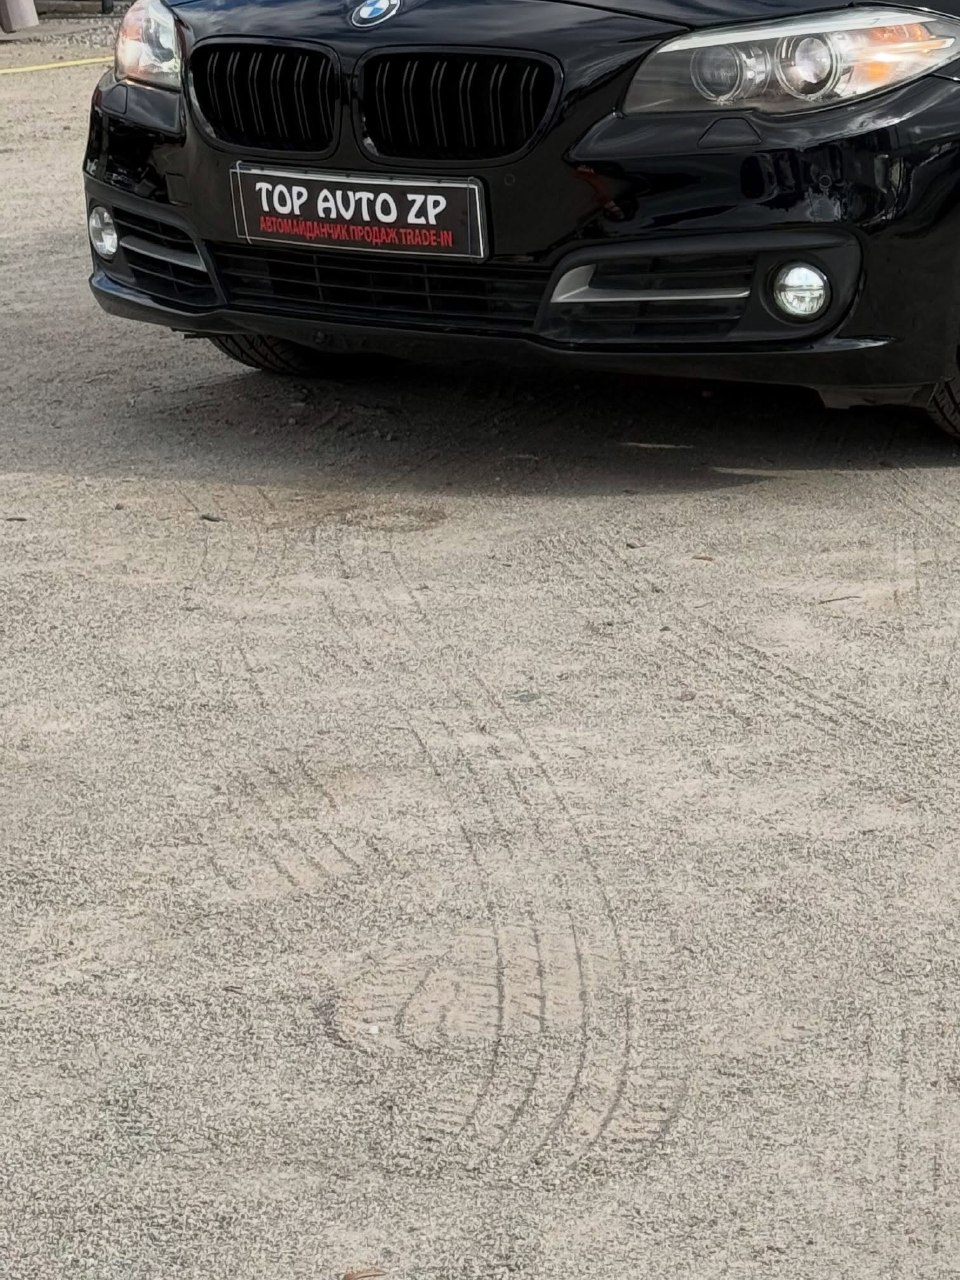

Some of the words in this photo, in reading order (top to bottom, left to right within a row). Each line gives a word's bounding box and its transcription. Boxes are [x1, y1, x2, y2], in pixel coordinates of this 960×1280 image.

[255, 182, 308, 215] TOP
[317, 188, 398, 223] AVTO
[406, 193, 447, 225] ZP
[259, 216, 349, 240] АВТОМАЙДАНЧИК
[351, 225, 398, 244] ПРОДАЖ
[400, 228, 453, 247] TRADE-IN
